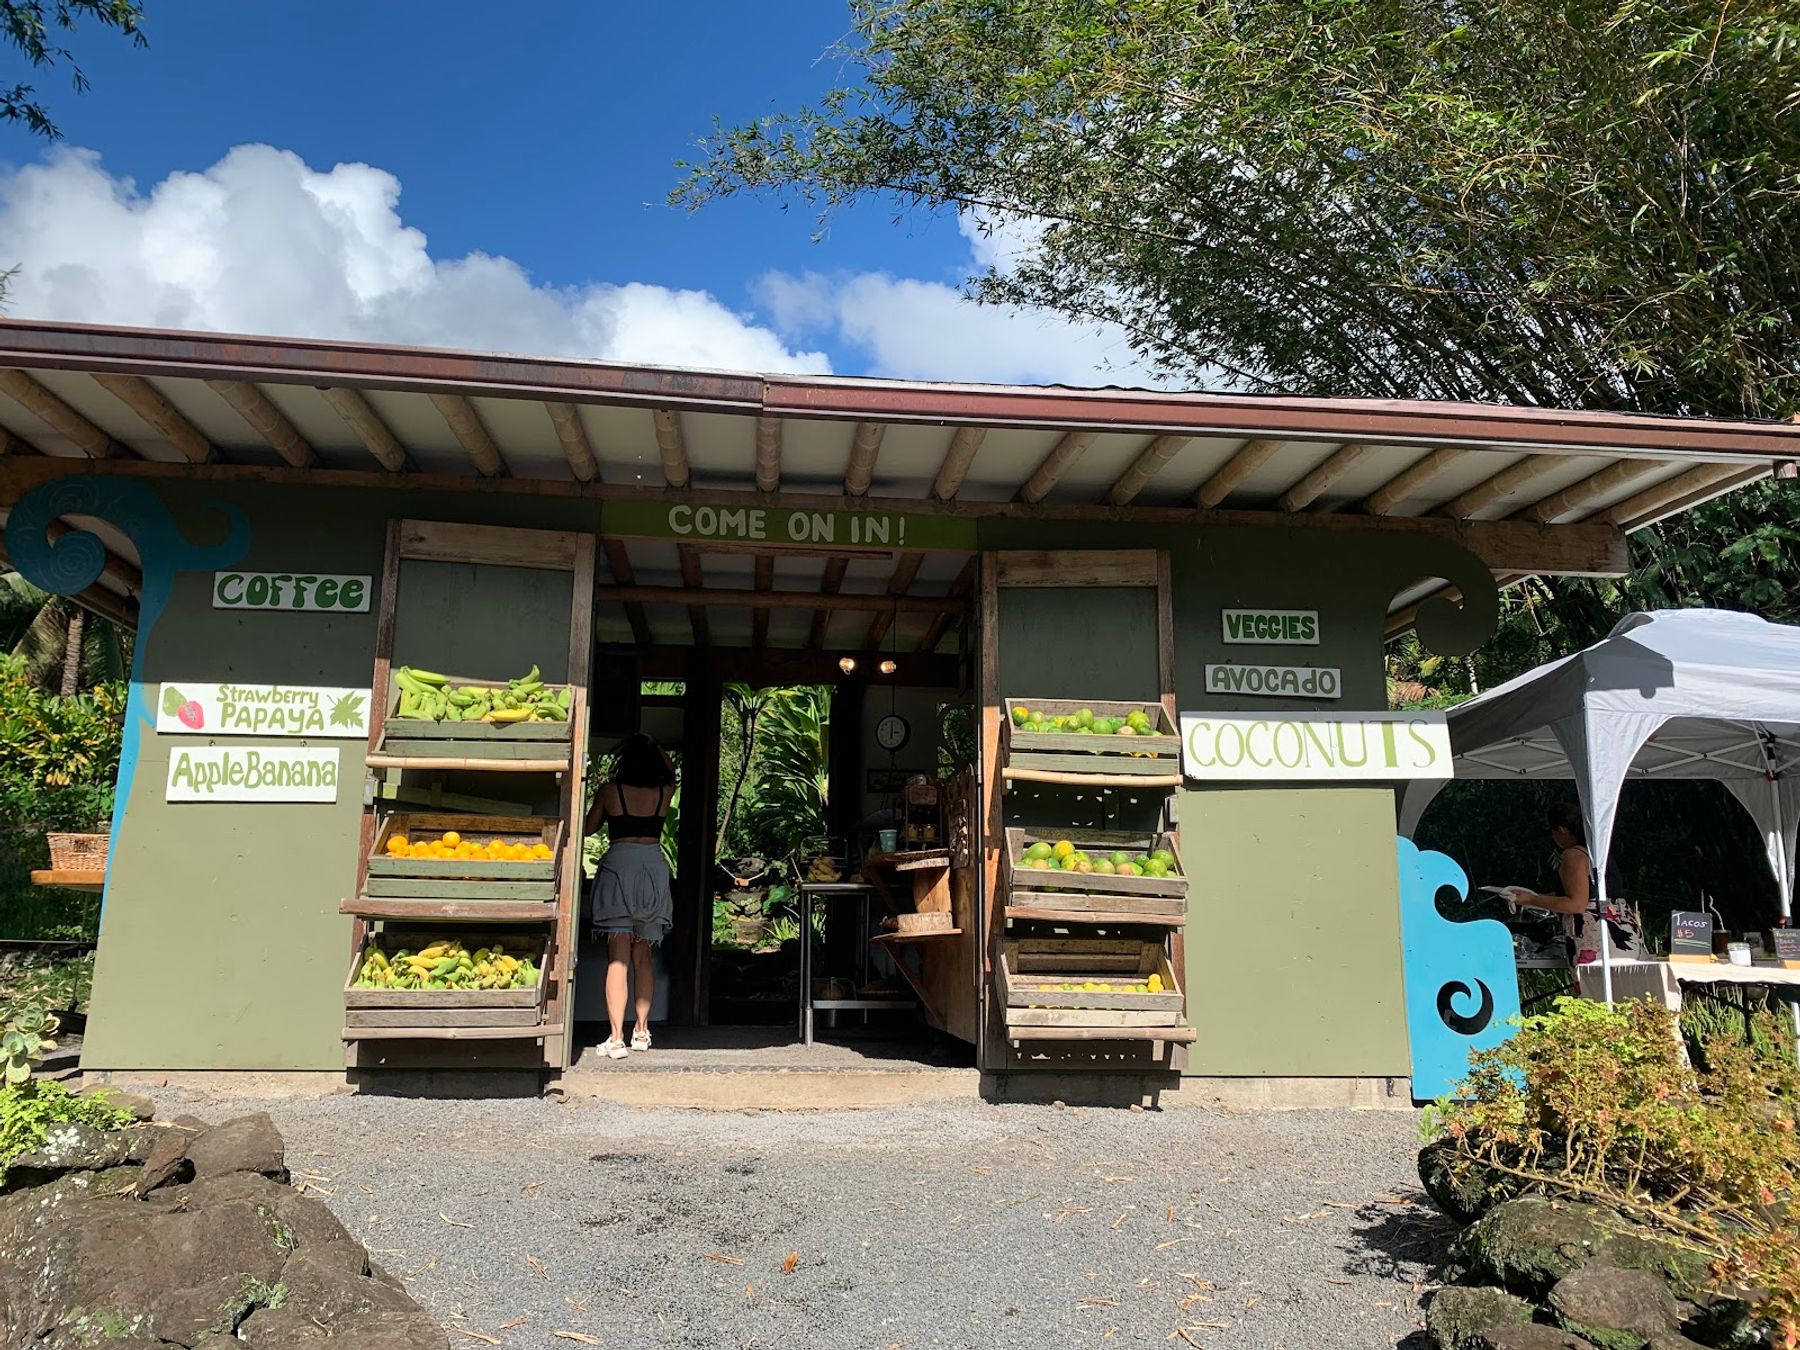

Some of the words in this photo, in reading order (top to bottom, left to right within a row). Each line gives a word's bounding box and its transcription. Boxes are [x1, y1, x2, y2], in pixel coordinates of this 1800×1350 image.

[668, 504, 766, 539] COME
[787, 511, 834, 542] ON
[850, 516, 906, 545] IN!
[1225, 614, 1316, 641] VEGGIES
[215, 683, 320, 710] Strawberry
[1188, 718, 1437, 770] COCONUTS
